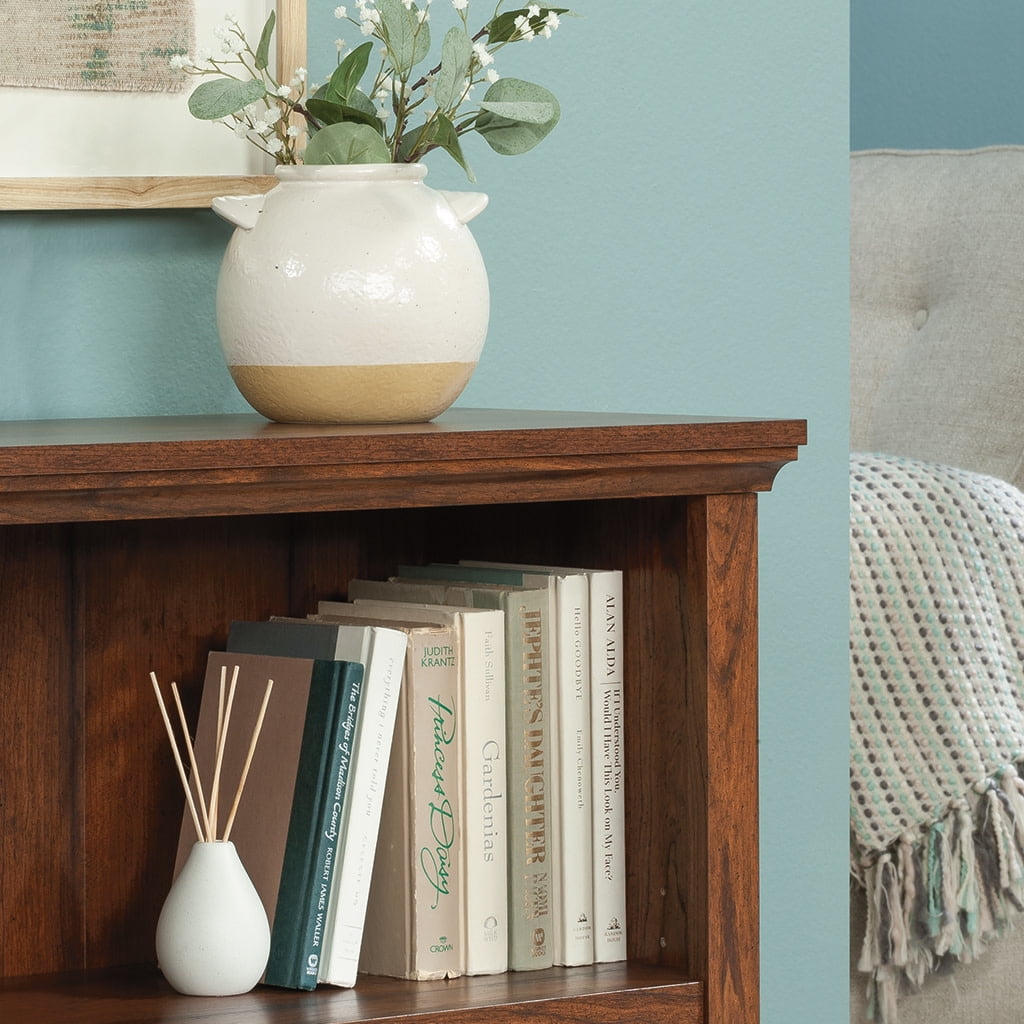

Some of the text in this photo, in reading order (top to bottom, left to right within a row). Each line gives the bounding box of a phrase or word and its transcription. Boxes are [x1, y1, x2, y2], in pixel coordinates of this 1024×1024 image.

[606, 594, 616, 677] ALAN ALDA
[421, 657, 455, 668] KRANTZ
[424, 646, 454, 658] JUDITH
[484, 631, 495, 702] Faith Sullivan
[574, 607, 583, 700] Hello GOODBYE
[603, 690, 612, 724] Would
[324, 682, 360, 841] The Bridges of Madison County
[603, 734, 612, 760] Have
[603, 762, 613, 786] This
[420, 695, 456, 910] Princess Daisy
[482, 740, 503, 863] Gardenias
[523, 729, 546, 865] DAUGHTER
[603, 788, 613, 815] Look
[604, 818, 611, 831] on
[601, 834, 613, 850] My
[604, 853, 613, 881] Face?
[312, 847, 333, 947] ROBERT JAMES WALLER
[430, 944, 454, 953] CROWN
